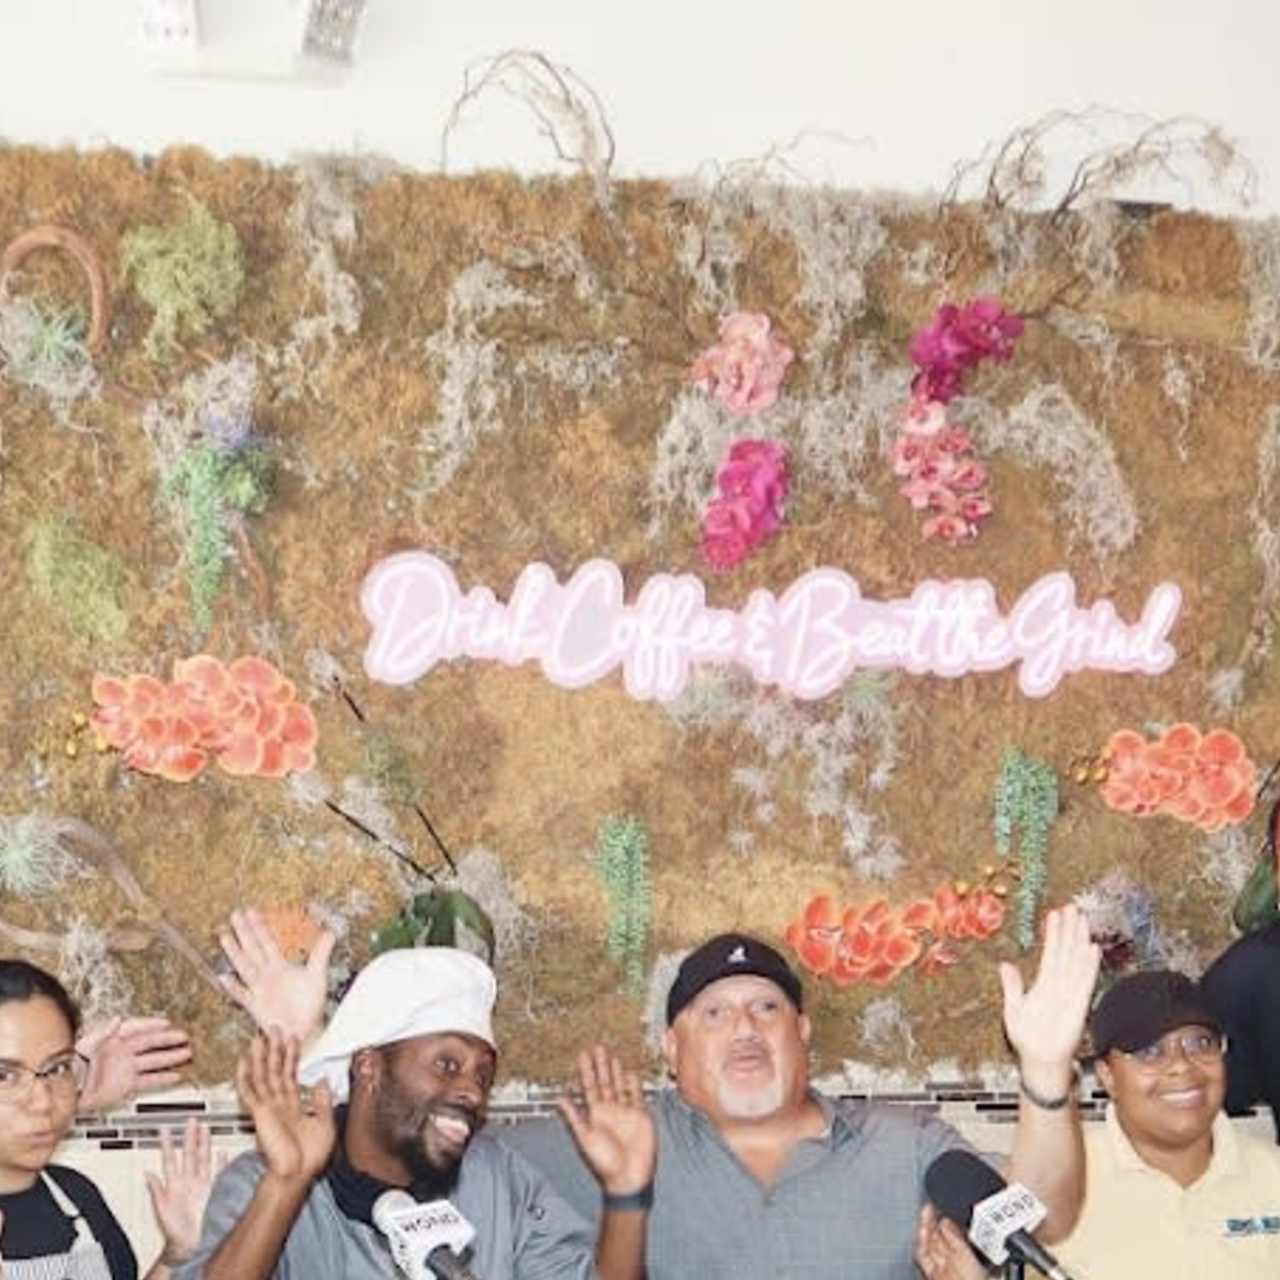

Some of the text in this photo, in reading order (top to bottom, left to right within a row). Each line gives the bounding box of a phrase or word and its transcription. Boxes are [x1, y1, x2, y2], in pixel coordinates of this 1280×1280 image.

[371, 555, 552, 675] Drink
[553, 565, 734, 696] Coffee
[1011, 574, 1177, 693] Grind
